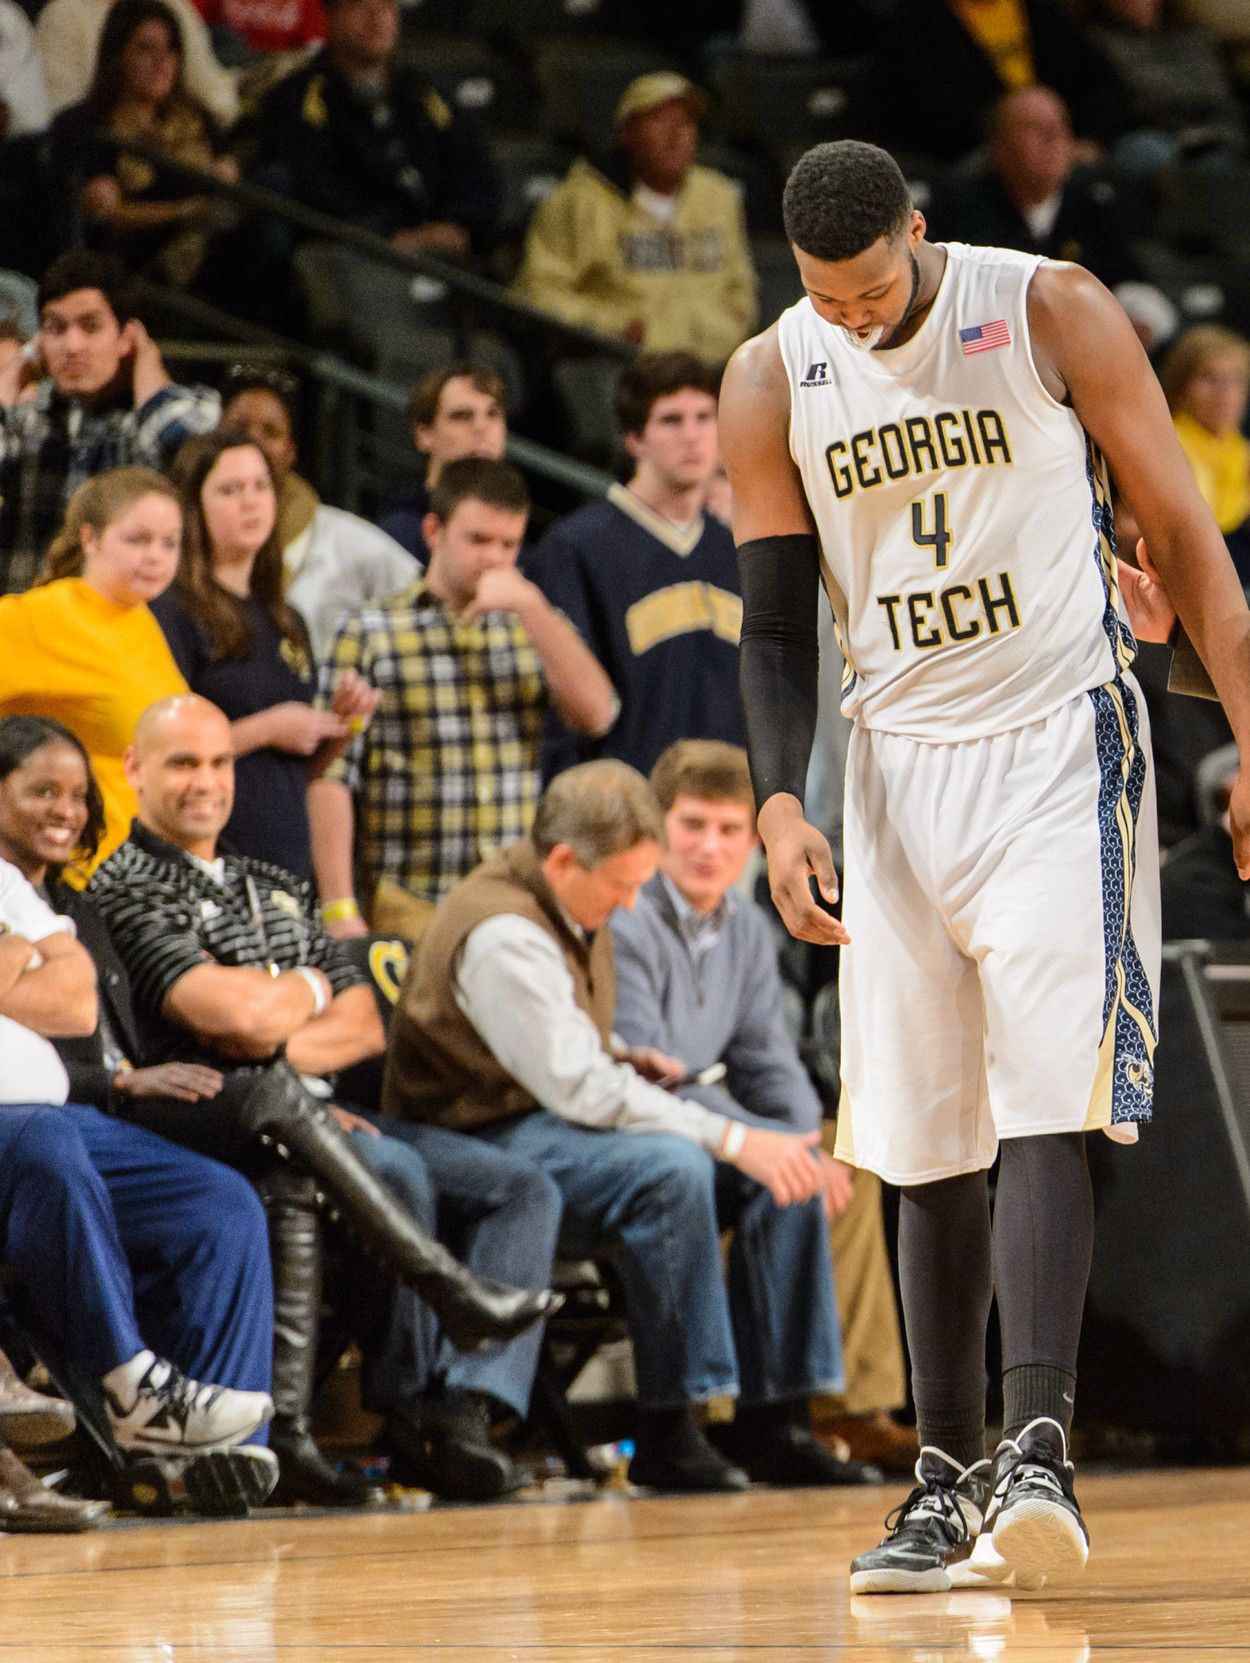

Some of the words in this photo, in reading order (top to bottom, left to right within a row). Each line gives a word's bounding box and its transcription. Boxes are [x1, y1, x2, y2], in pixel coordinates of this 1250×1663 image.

[800, 379, 832, 387] RUSSELL
[825, 409, 1013, 500] GEORGIA
[910, 491, 953, 570] 4
[877, 572, 1021, 650] TECH
